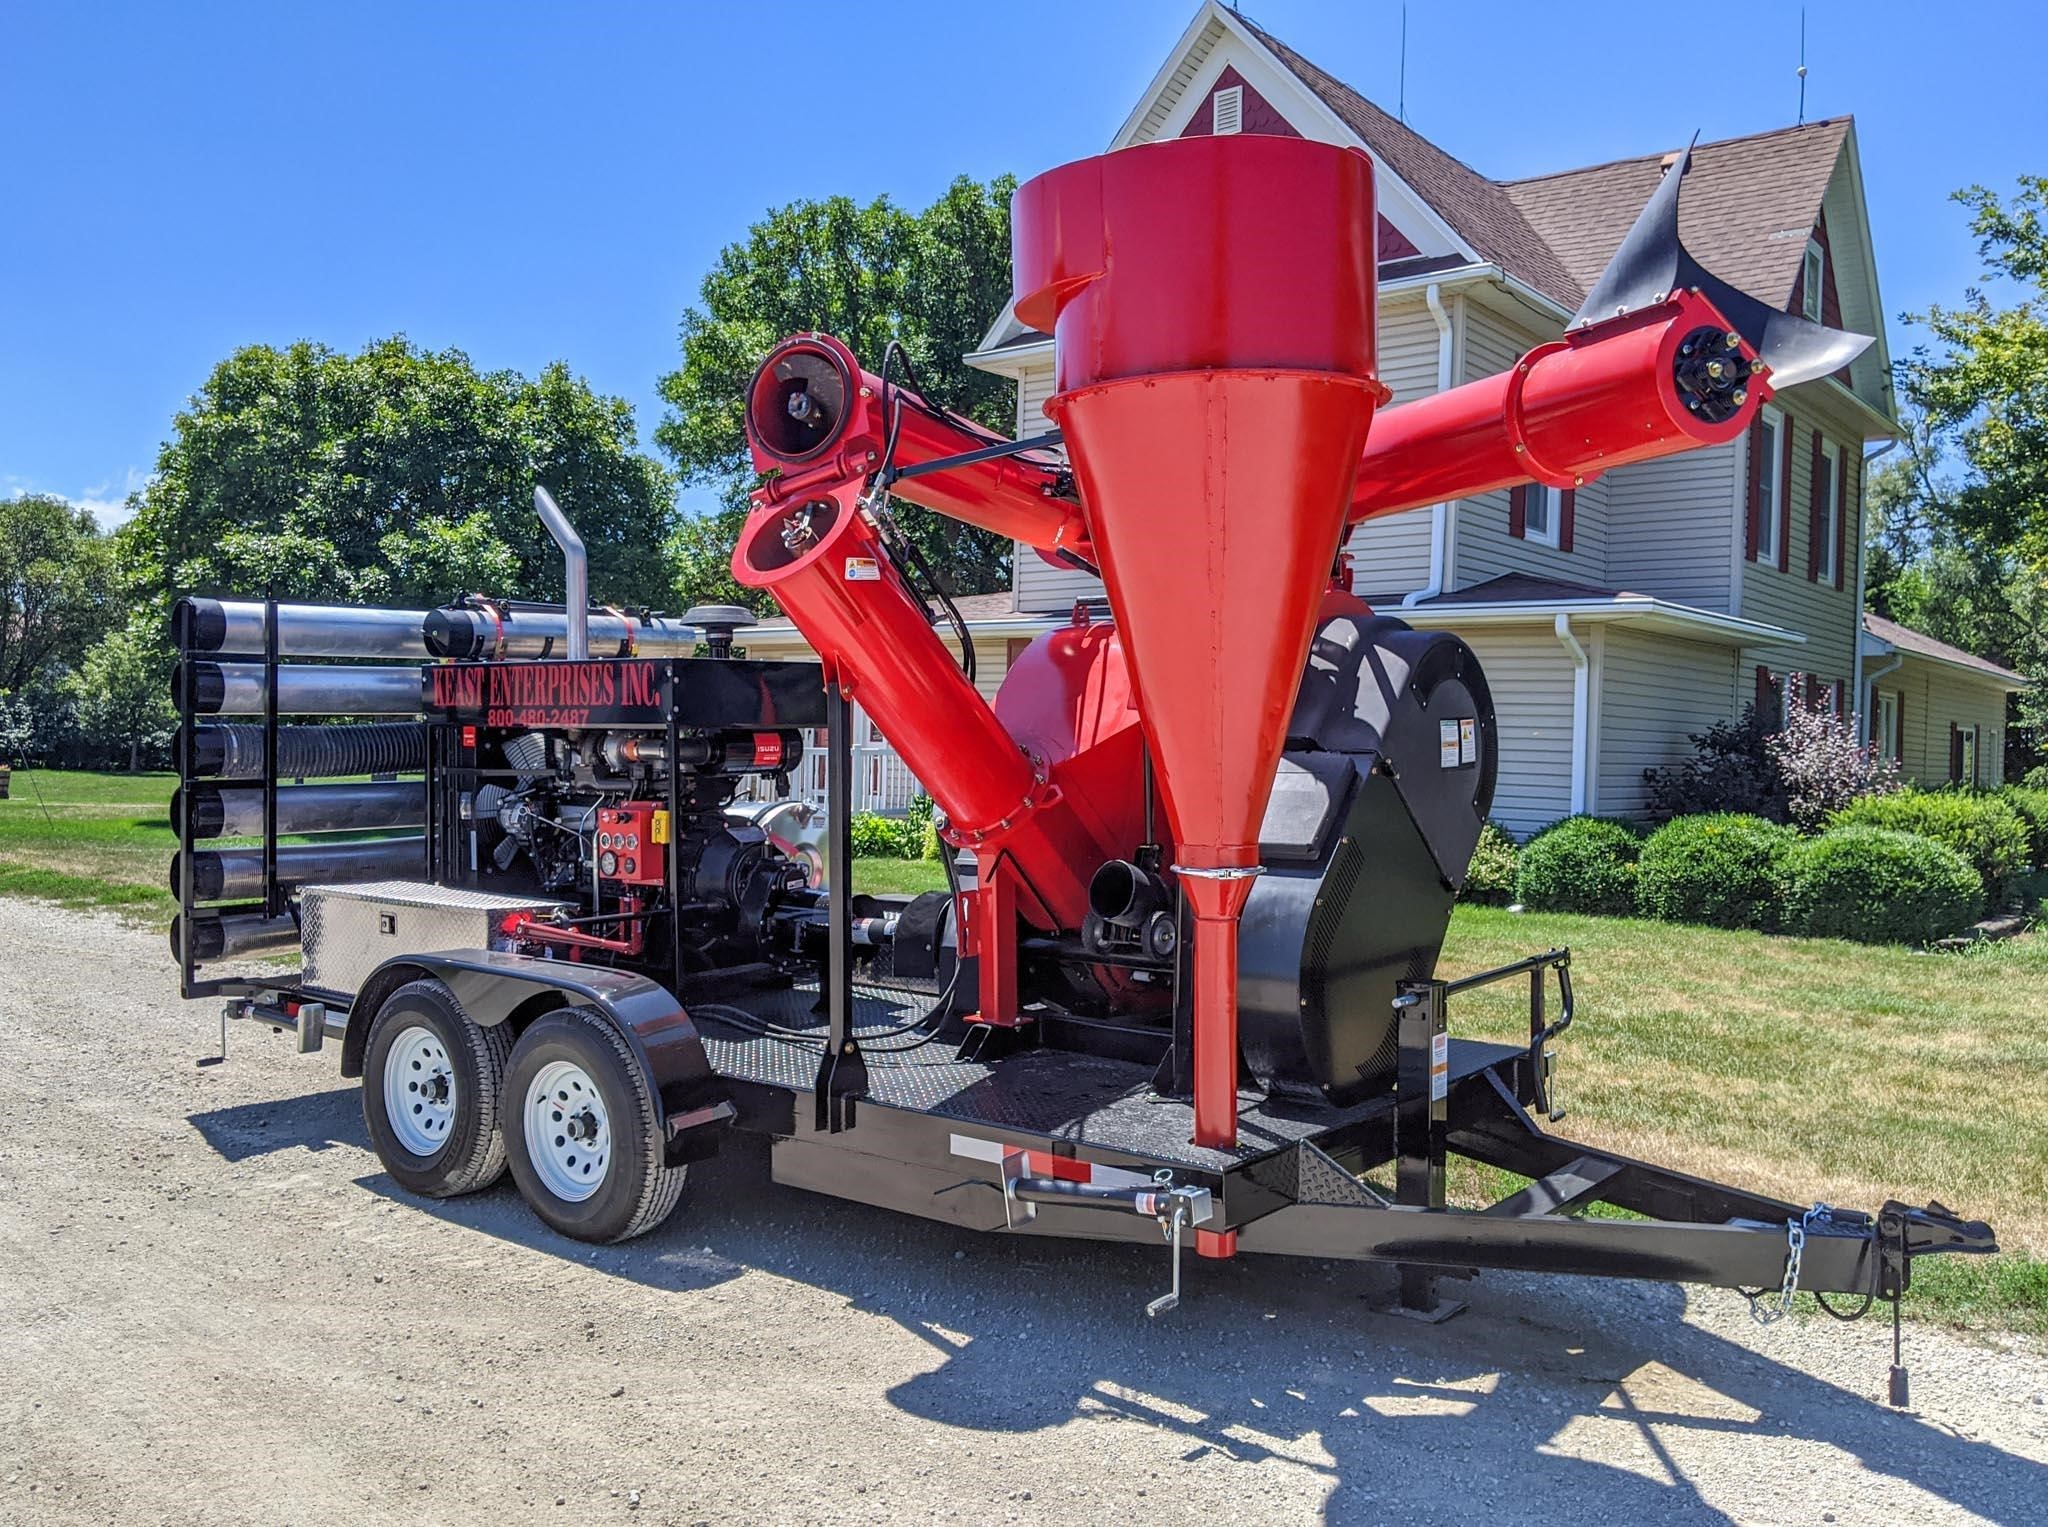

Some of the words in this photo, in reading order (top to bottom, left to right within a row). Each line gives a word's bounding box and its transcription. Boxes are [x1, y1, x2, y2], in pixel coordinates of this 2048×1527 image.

[432, 667, 484, 707] KEAST
[489, 664, 614, 706] ENTERPRISES
[620, 662, 661, 706] INC.
[487, 709, 589, 727] 800-480-2487
